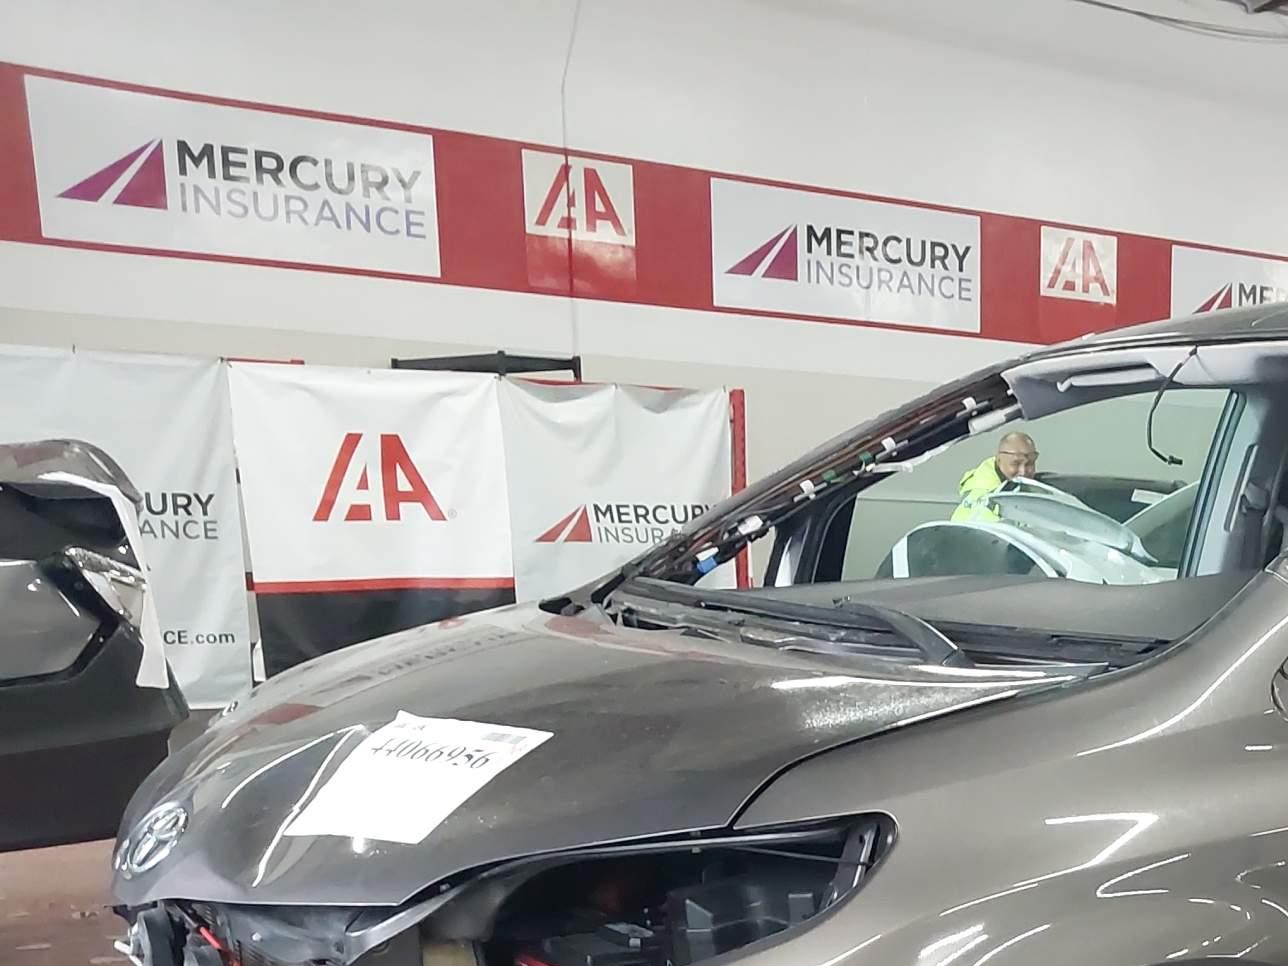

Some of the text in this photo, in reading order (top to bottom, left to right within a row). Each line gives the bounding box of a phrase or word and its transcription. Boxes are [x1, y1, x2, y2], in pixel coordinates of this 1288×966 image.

[177, 140, 422, 204] MERCURY
[179, 182, 427, 239] INSURANCE
[806, 224, 972, 272] MERCURY
[807, 259, 973, 301] INSURANCE
[371, 738, 497, 768] 44066956
